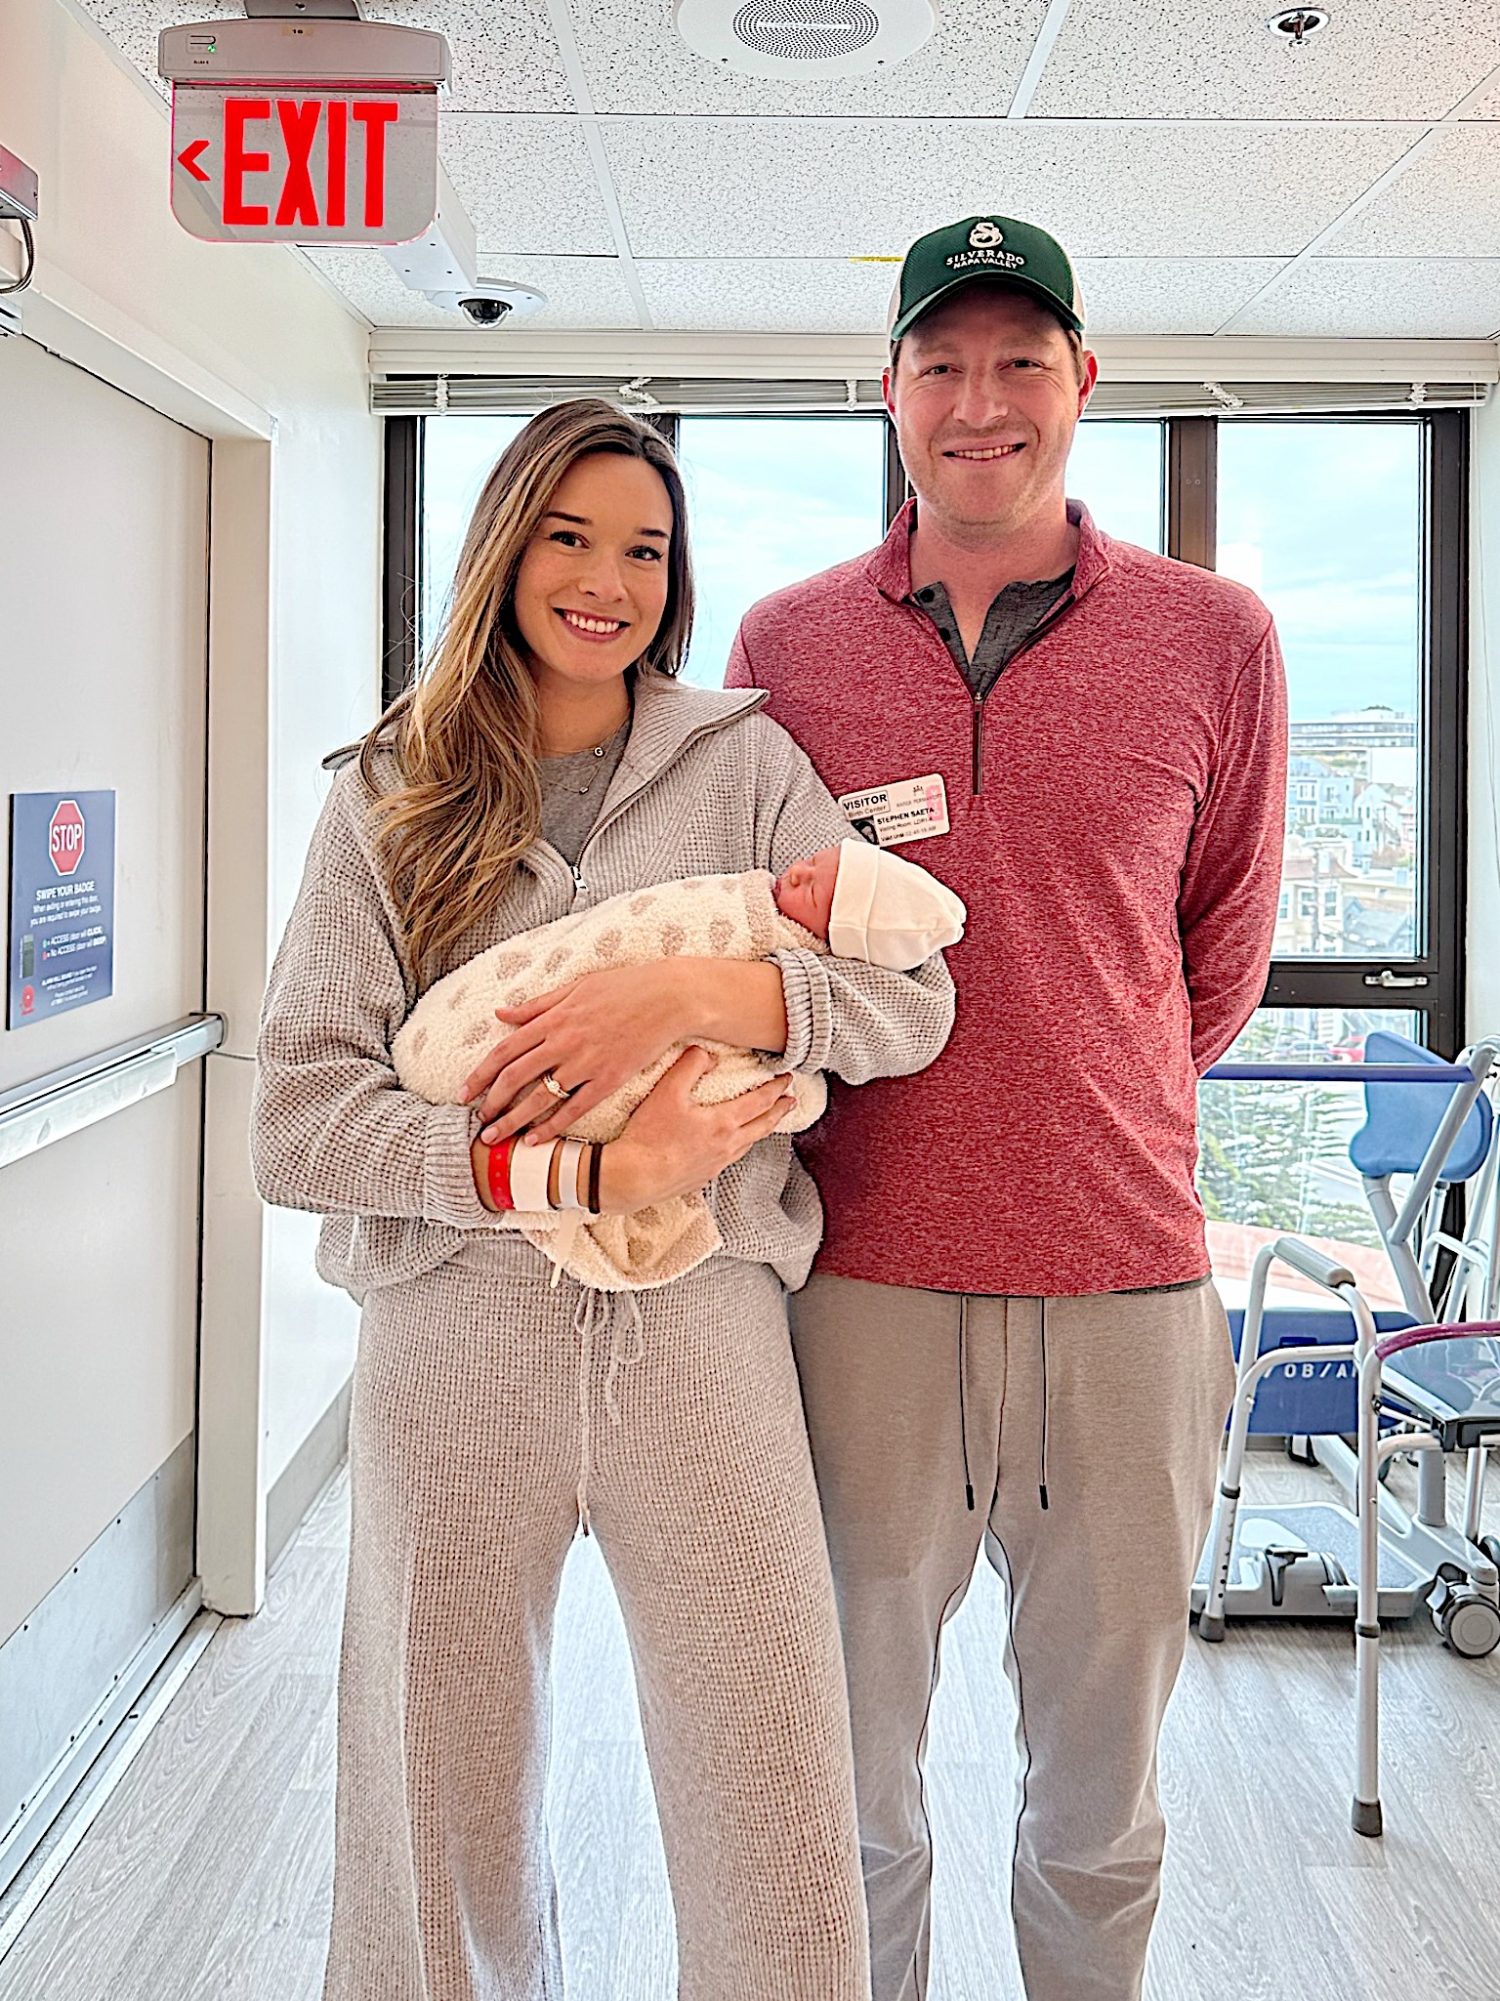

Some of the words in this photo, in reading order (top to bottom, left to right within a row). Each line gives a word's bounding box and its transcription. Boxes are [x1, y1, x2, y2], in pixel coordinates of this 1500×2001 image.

[222, 97, 399, 228] EXIT
[946, 249, 1025, 266] SILVERADO
[953, 258, 980, 269] NAPA
[981, 257, 1018, 269] VALLEY
[843, 793, 888, 811] VISITOR
[864, 805, 886, 815] Center
[877, 812, 910, 824] STEPHEN
[911, 807, 935, 818] SAETA
[52, 823, 82, 853] STOP
[36, 887, 57, 901] SWIPE
[57, 884, 74, 897] YOUR
[74, 880, 95, 895] BADGE
[51, 933, 70, 945] ACCESS
[58, 943, 76, 955] ACCESS
